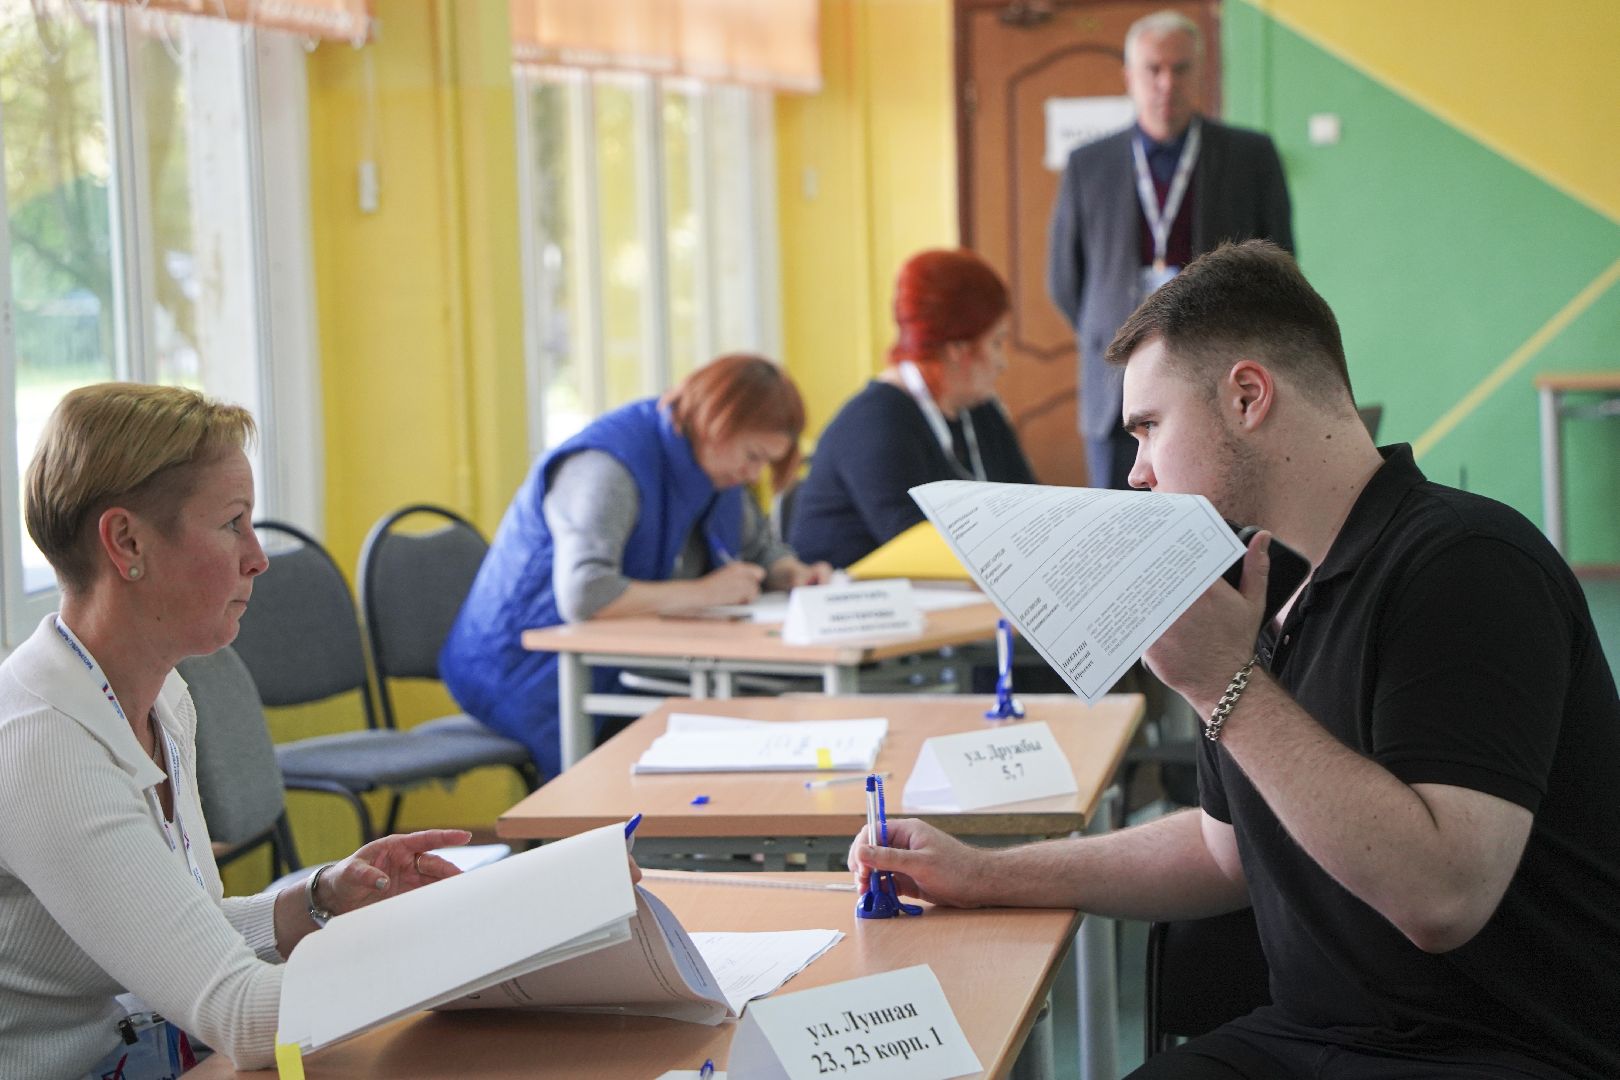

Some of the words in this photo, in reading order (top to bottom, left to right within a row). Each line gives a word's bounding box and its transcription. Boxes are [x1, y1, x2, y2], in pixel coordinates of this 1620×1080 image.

[987, 739, 1042, 761] Дружбы
[806, 1023, 840, 1046] ул.
[842, 1001, 919, 1035] Лунная
[811, 1051, 847, 1074] 23,
[844, 1043, 871, 1067] 23
[873, 1034, 930, 1061] корп.
[928, 1026, 944, 1046] 1
